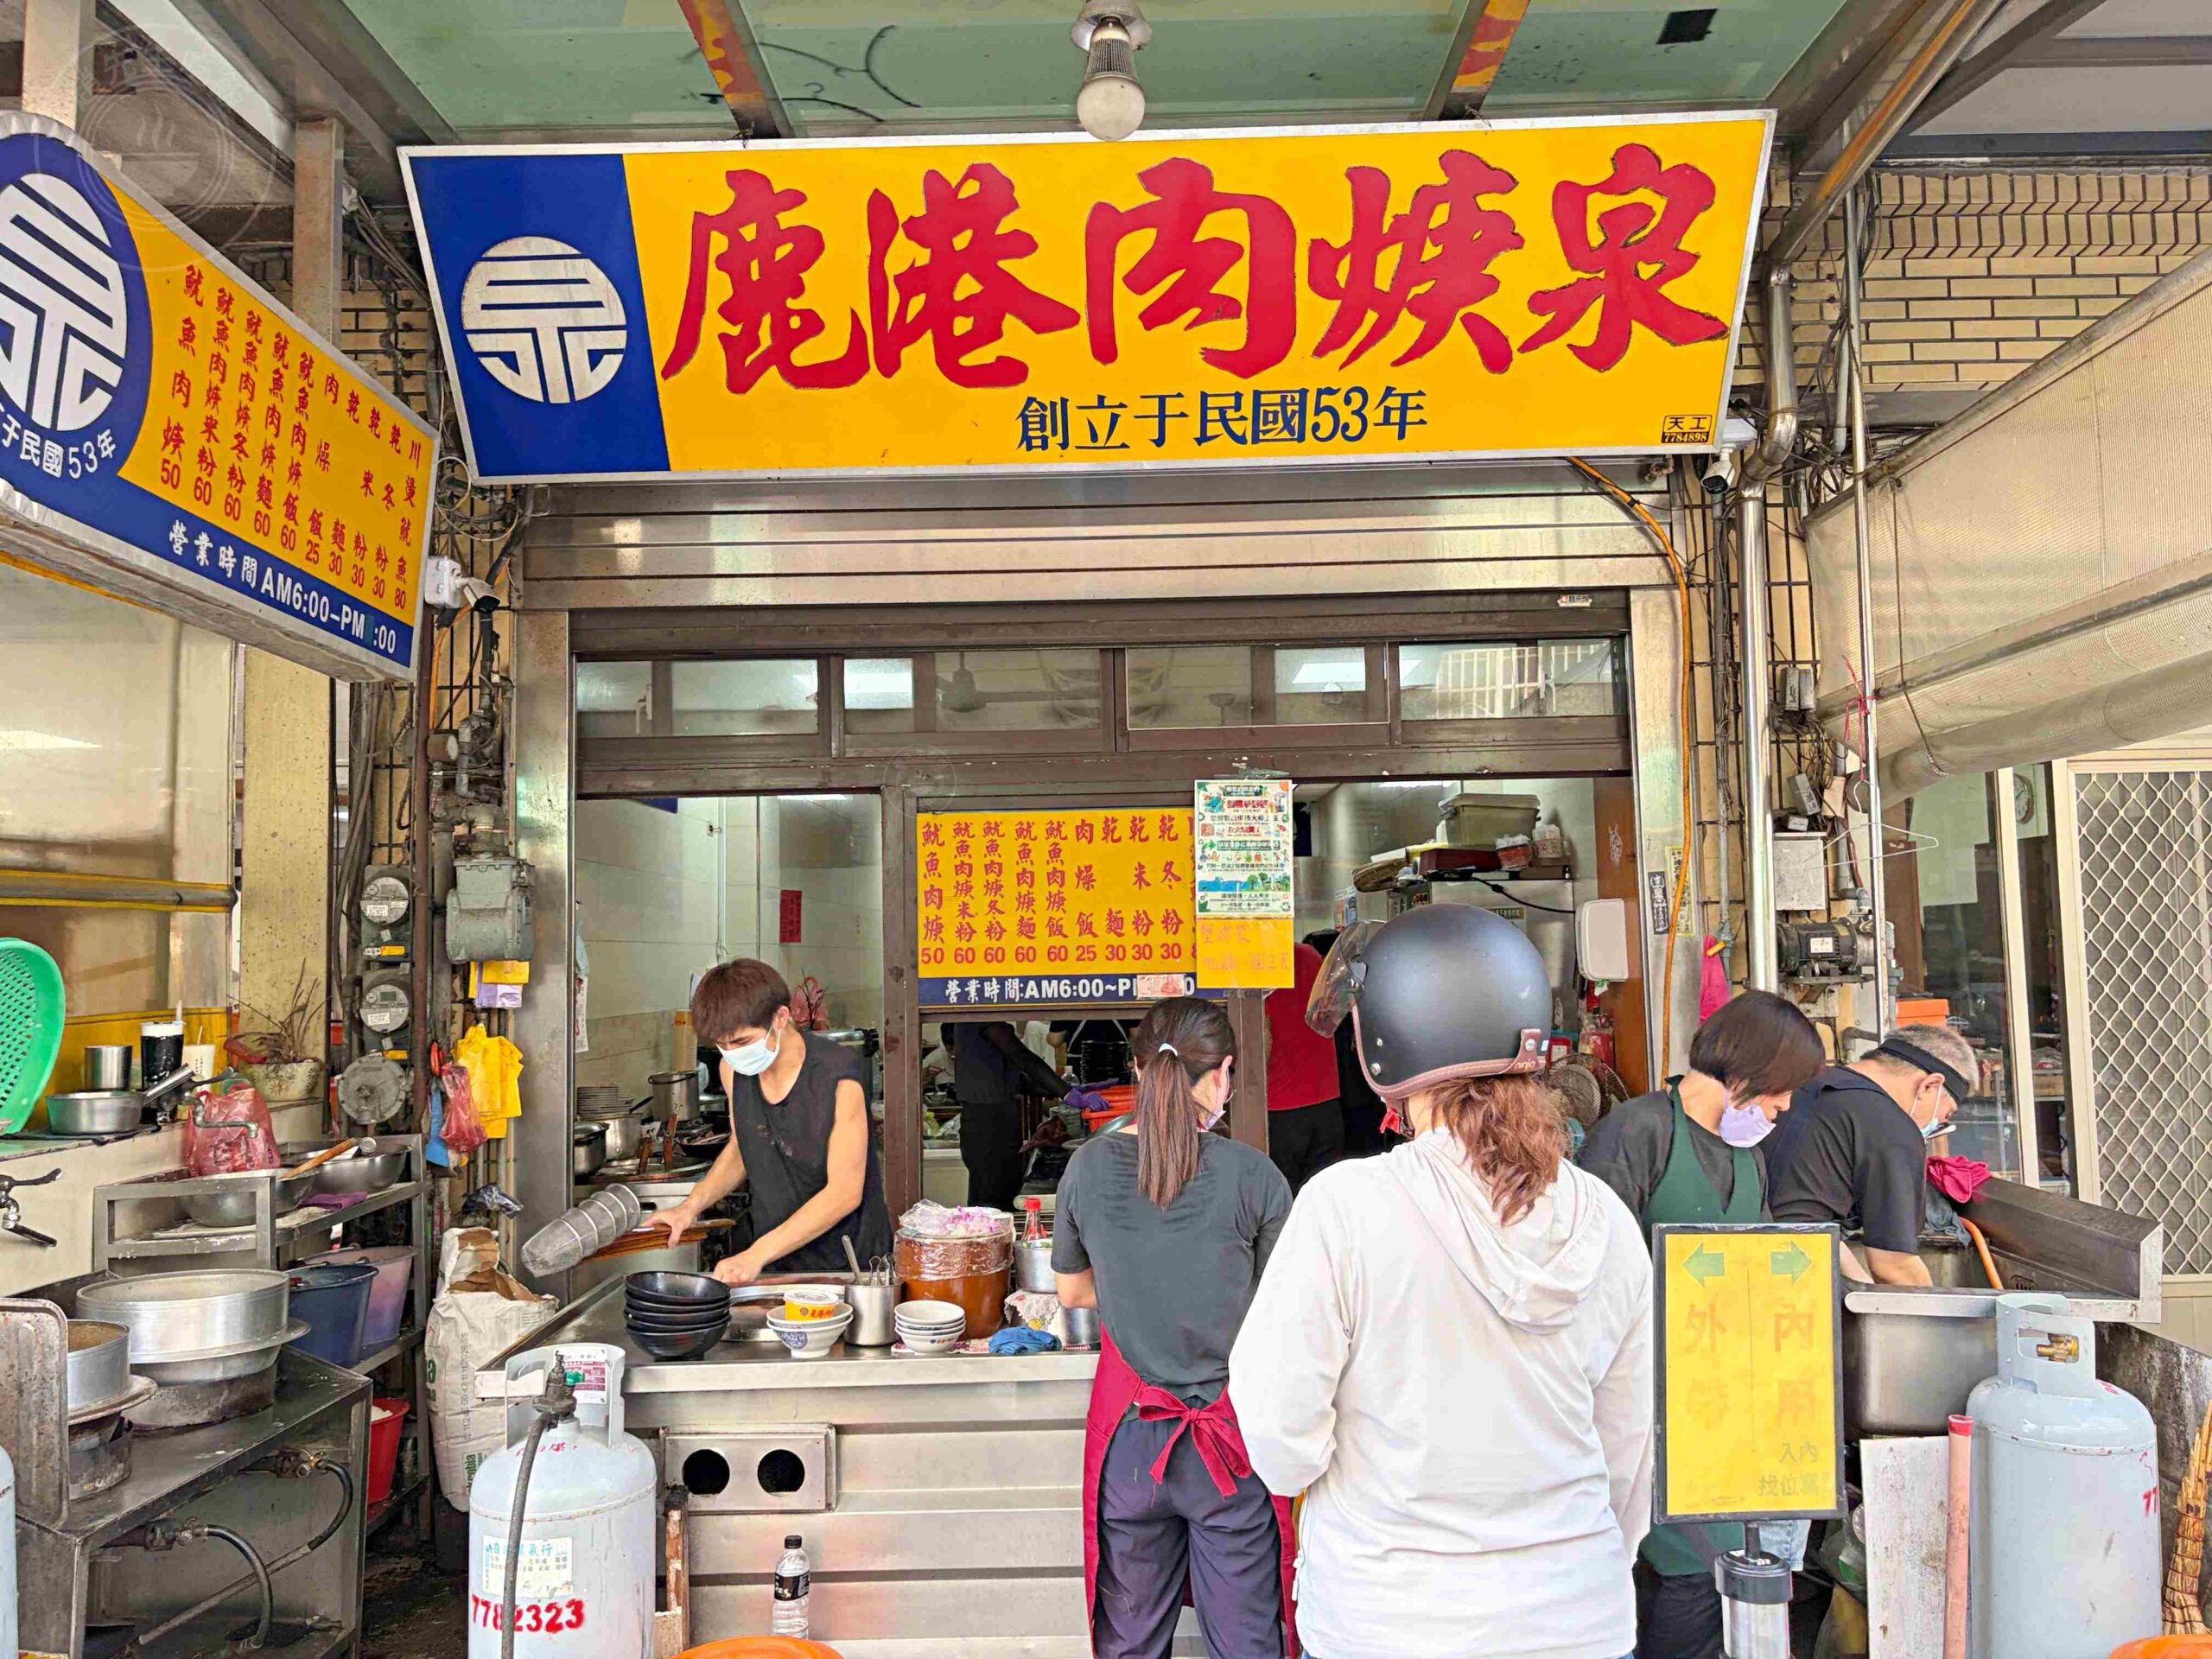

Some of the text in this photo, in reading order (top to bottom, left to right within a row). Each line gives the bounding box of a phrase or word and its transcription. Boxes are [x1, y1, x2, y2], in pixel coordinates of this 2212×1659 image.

[661, 143, 1729, 394] 鹿港肉焿泉
[1017, 385, 1427, 452] 創立于民國53年
[1668, 416, 1707, 430] 天工
[0, 403, 116, 479] 于民國53年
[1664, 432, 1707, 442] 7784898
[161, 464, 181, 490] 50
[194, 478, 213, 506] 60
[224, 493, 242, 522] 60
[254, 510, 270, 537] 60
[281, 524, 296, 551] 60
[305, 538, 320, 565] 25
[328, 550, 342, 576] 30
[351, 563, 365, 588] 30
[372, 575, 385, 599] 30
[394, 588, 406, 610] 80
[921, 948, 944, 964] 50
[954, 947, 976, 963] 60
[984, 947, 1005, 963] 60
[1015, 946, 1036, 963] 60
[1047, 945, 1068, 962] 60
[1076, 944, 1096, 961] 25
[1105, 944, 1126, 961] 30
[1132, 944, 1153, 961] 30
[1160, 943, 1181, 960] 30
